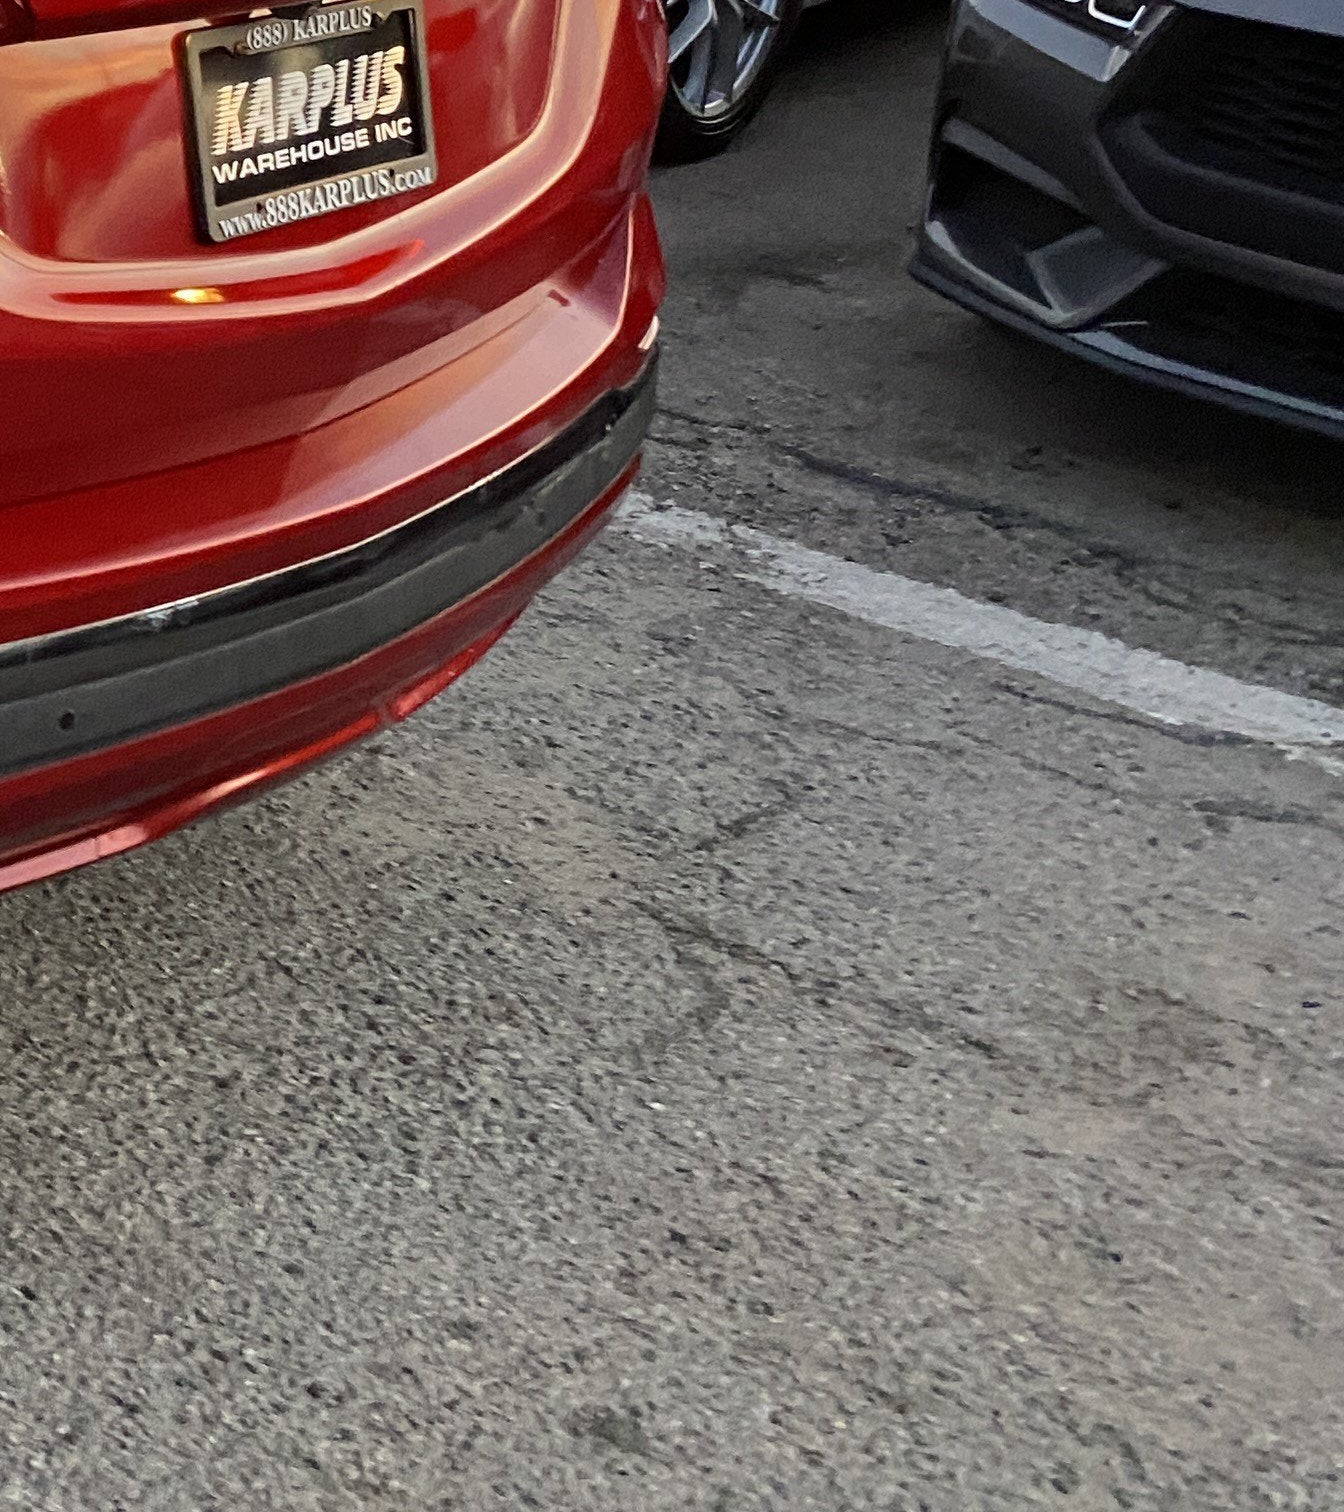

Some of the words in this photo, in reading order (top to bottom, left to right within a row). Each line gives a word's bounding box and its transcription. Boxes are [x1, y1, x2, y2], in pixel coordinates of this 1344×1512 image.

[246, 21, 289, 51] (888)
[292, 5, 373, 42] KARPLUS
[210, 45, 405, 156] KARPLUS
[212, 128, 370, 184] WAREHOUSE
[374, 116, 413, 144] INC
